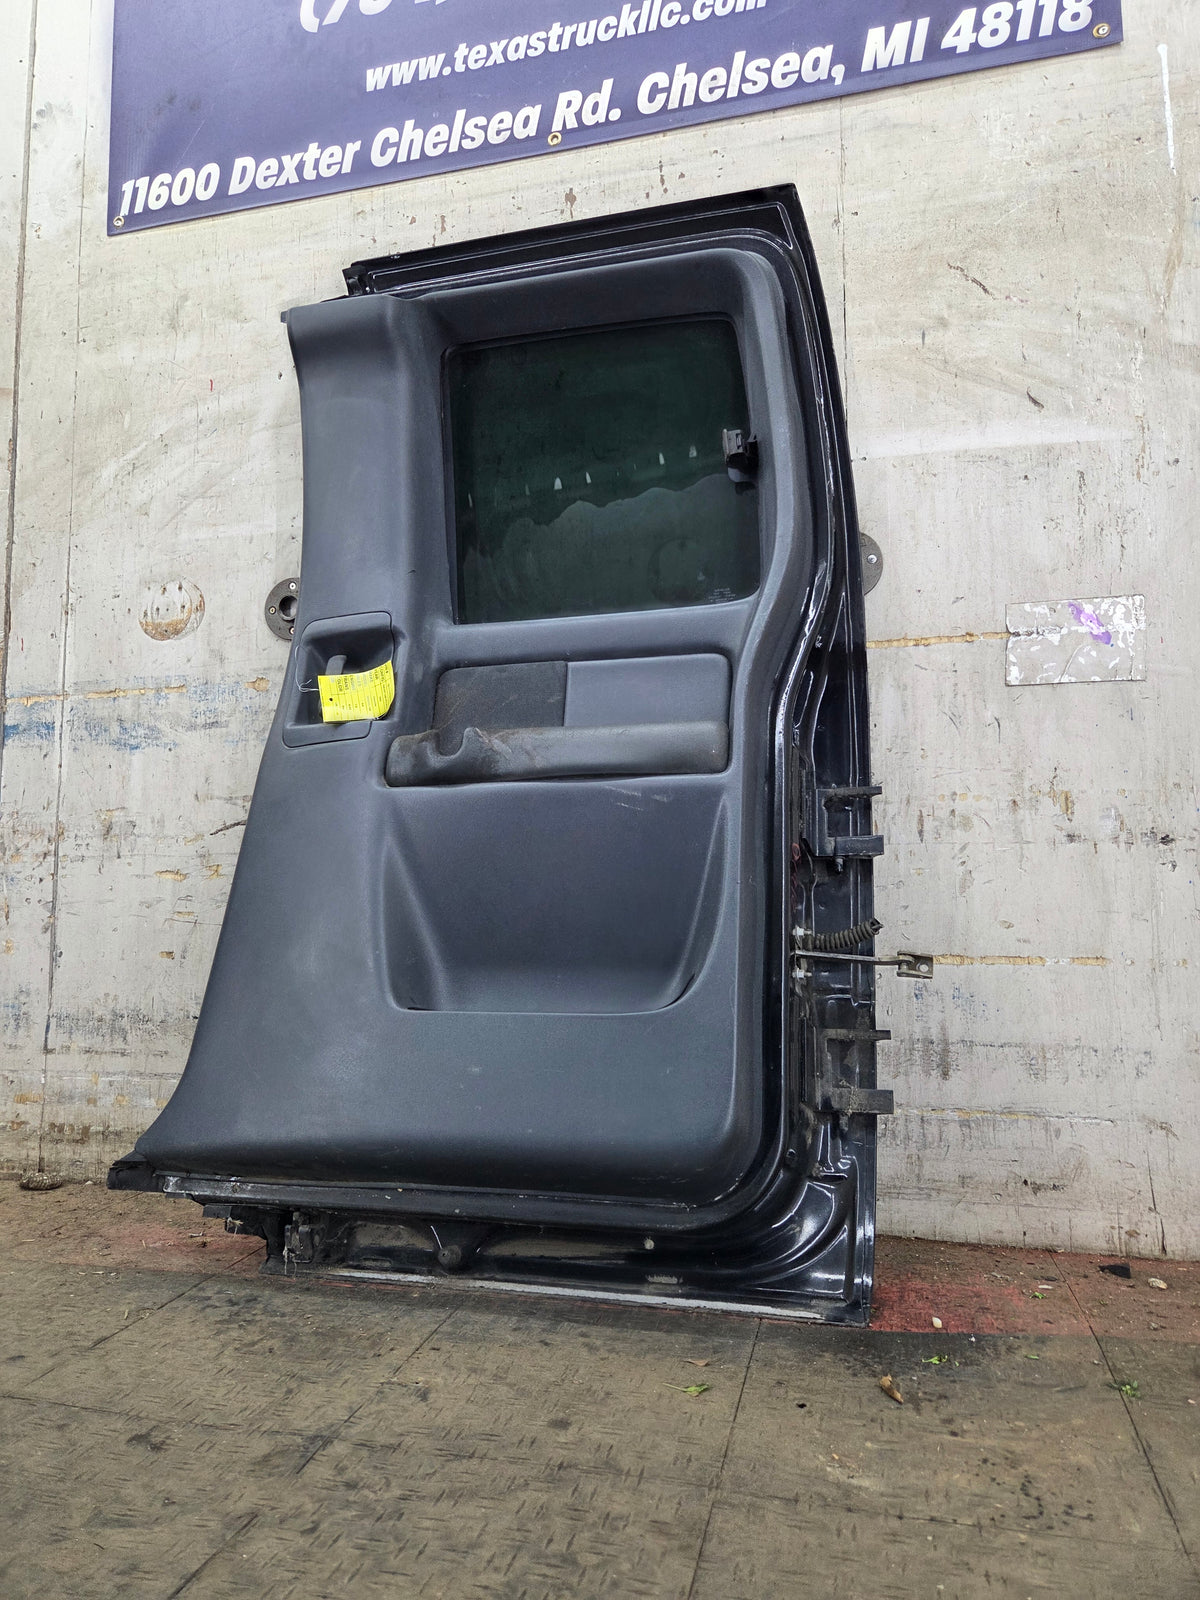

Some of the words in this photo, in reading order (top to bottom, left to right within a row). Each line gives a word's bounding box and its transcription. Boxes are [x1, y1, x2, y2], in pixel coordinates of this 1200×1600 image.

[120, 161, 220, 217] 11600
[228, 139, 362, 196] Dexter
[370, 103, 542, 169] Chelsea
[551, 77, 622, 133] Rd.
[636, 44, 846, 116] Chelsea,
[861, 20, 931, 74] MI
[940, 0, 1094, 54] 48118
